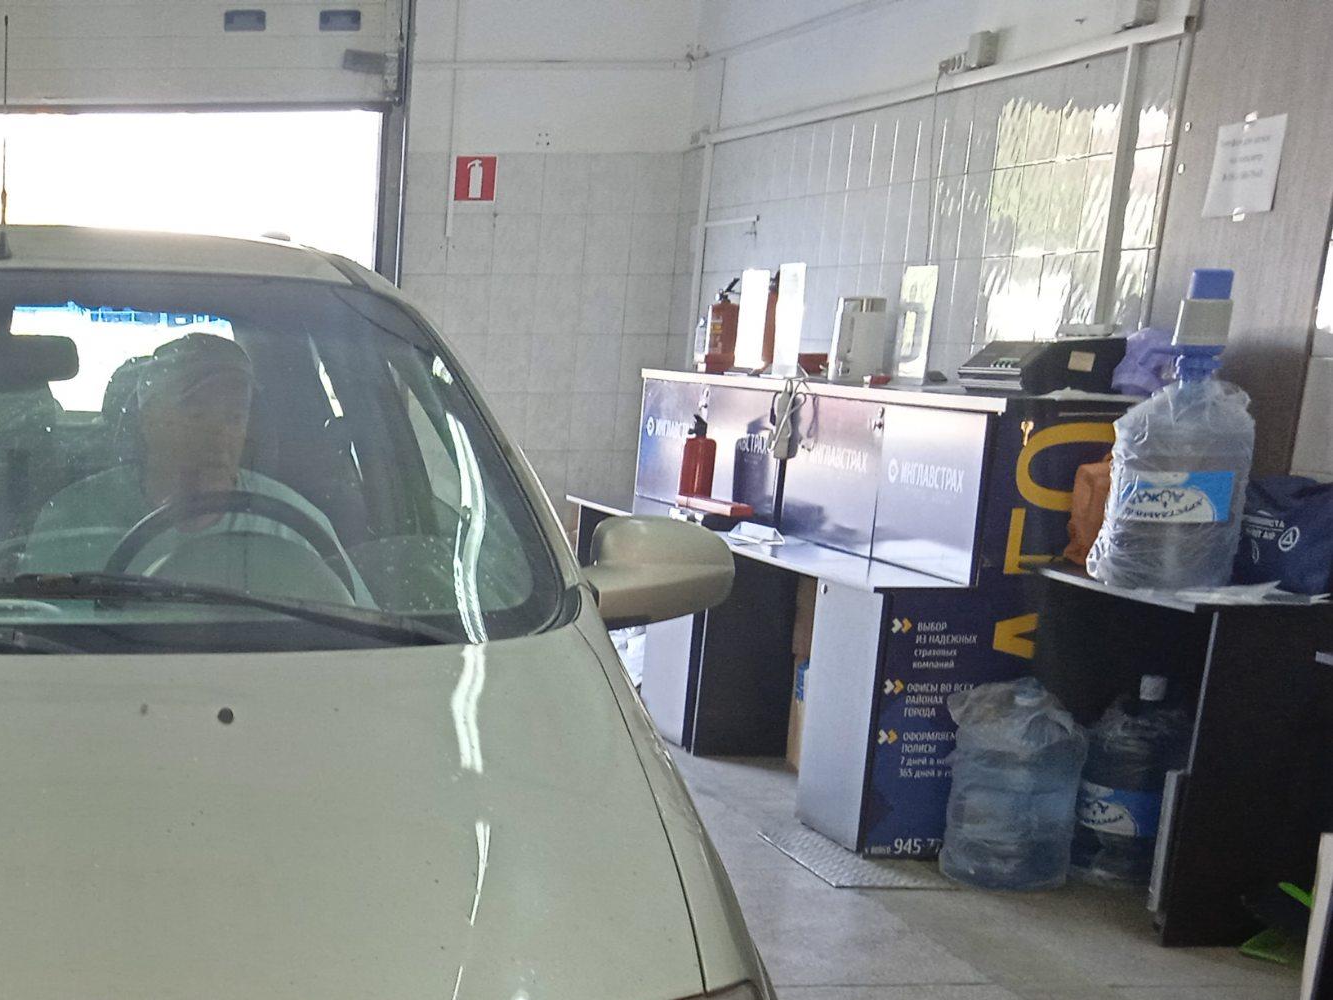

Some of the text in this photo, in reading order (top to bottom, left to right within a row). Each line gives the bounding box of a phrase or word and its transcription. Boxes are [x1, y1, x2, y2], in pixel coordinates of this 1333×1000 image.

[901, 462, 965, 493] ИНГЛАВСТРАХ
[917, 622, 948, 632] ВЫБОР
[915, 634, 927, 644] ИЗ
[903, 707, 936, 717] ГОРОДА
